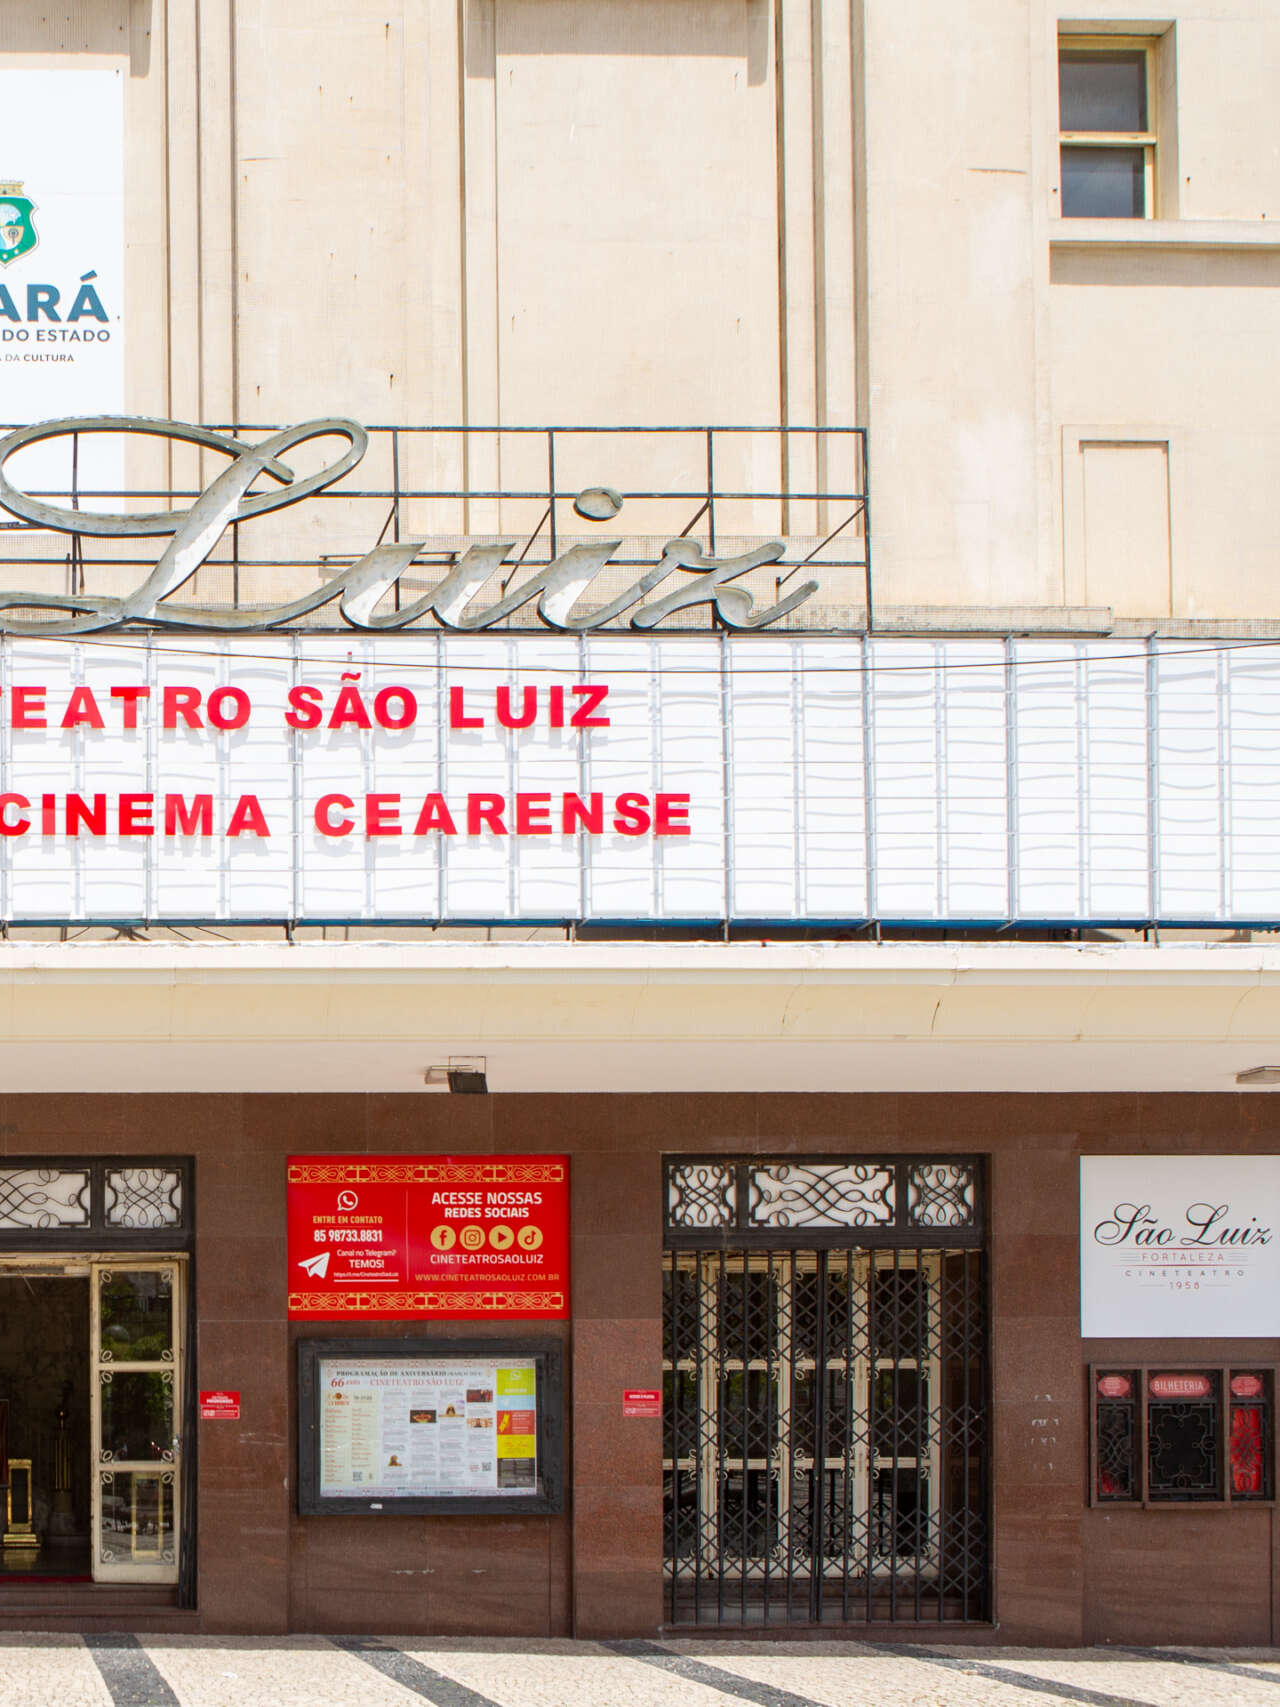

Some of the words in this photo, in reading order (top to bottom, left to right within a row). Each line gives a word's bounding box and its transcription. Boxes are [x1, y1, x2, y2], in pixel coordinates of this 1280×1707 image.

[2, 329, 29, 342] DO
[36, 329, 111, 342] ESTADO
[5, 353, 21, 362] DA
[23, 353, 75, 362] CULTURA
[284, 672, 418, 730] SÃO
[450, 685, 611, 728] LUIZ
[313, 792, 692, 836] CEARENSE
[431, 1192, 482, 1205] ACESSE
[487, 1192, 542, 1205] NOSSAS
[444, 1207, 481, 1218] REDES
[485, 1207, 529, 1218] SOCIAIS
[313, 1215, 337, 1224] ENTRE
[338, 1215, 349, 1224] EM
[350, 1215, 383, 1224] CONTATO
[1094, 1203, 1175, 1246] São
[1180, 1203, 1272, 1246] Luiz
[314, 1230, 326, 1242] 85
[328, 1230, 383, 1242] 98733.8831
[336, 1249, 354, 1257] Canal
[366, 1249, 396, 1258] Telegram?
[1142, 1253, 1224, 1262] FORTALEZA
[349, 1259, 384, 1269] TEMOS!
[430, 1254, 543, 1265] CINETEATROSAOLUIZ
[331, 1378, 344, 1387] 66
[1154, 1381, 1203, 1391] BILHETERIA
